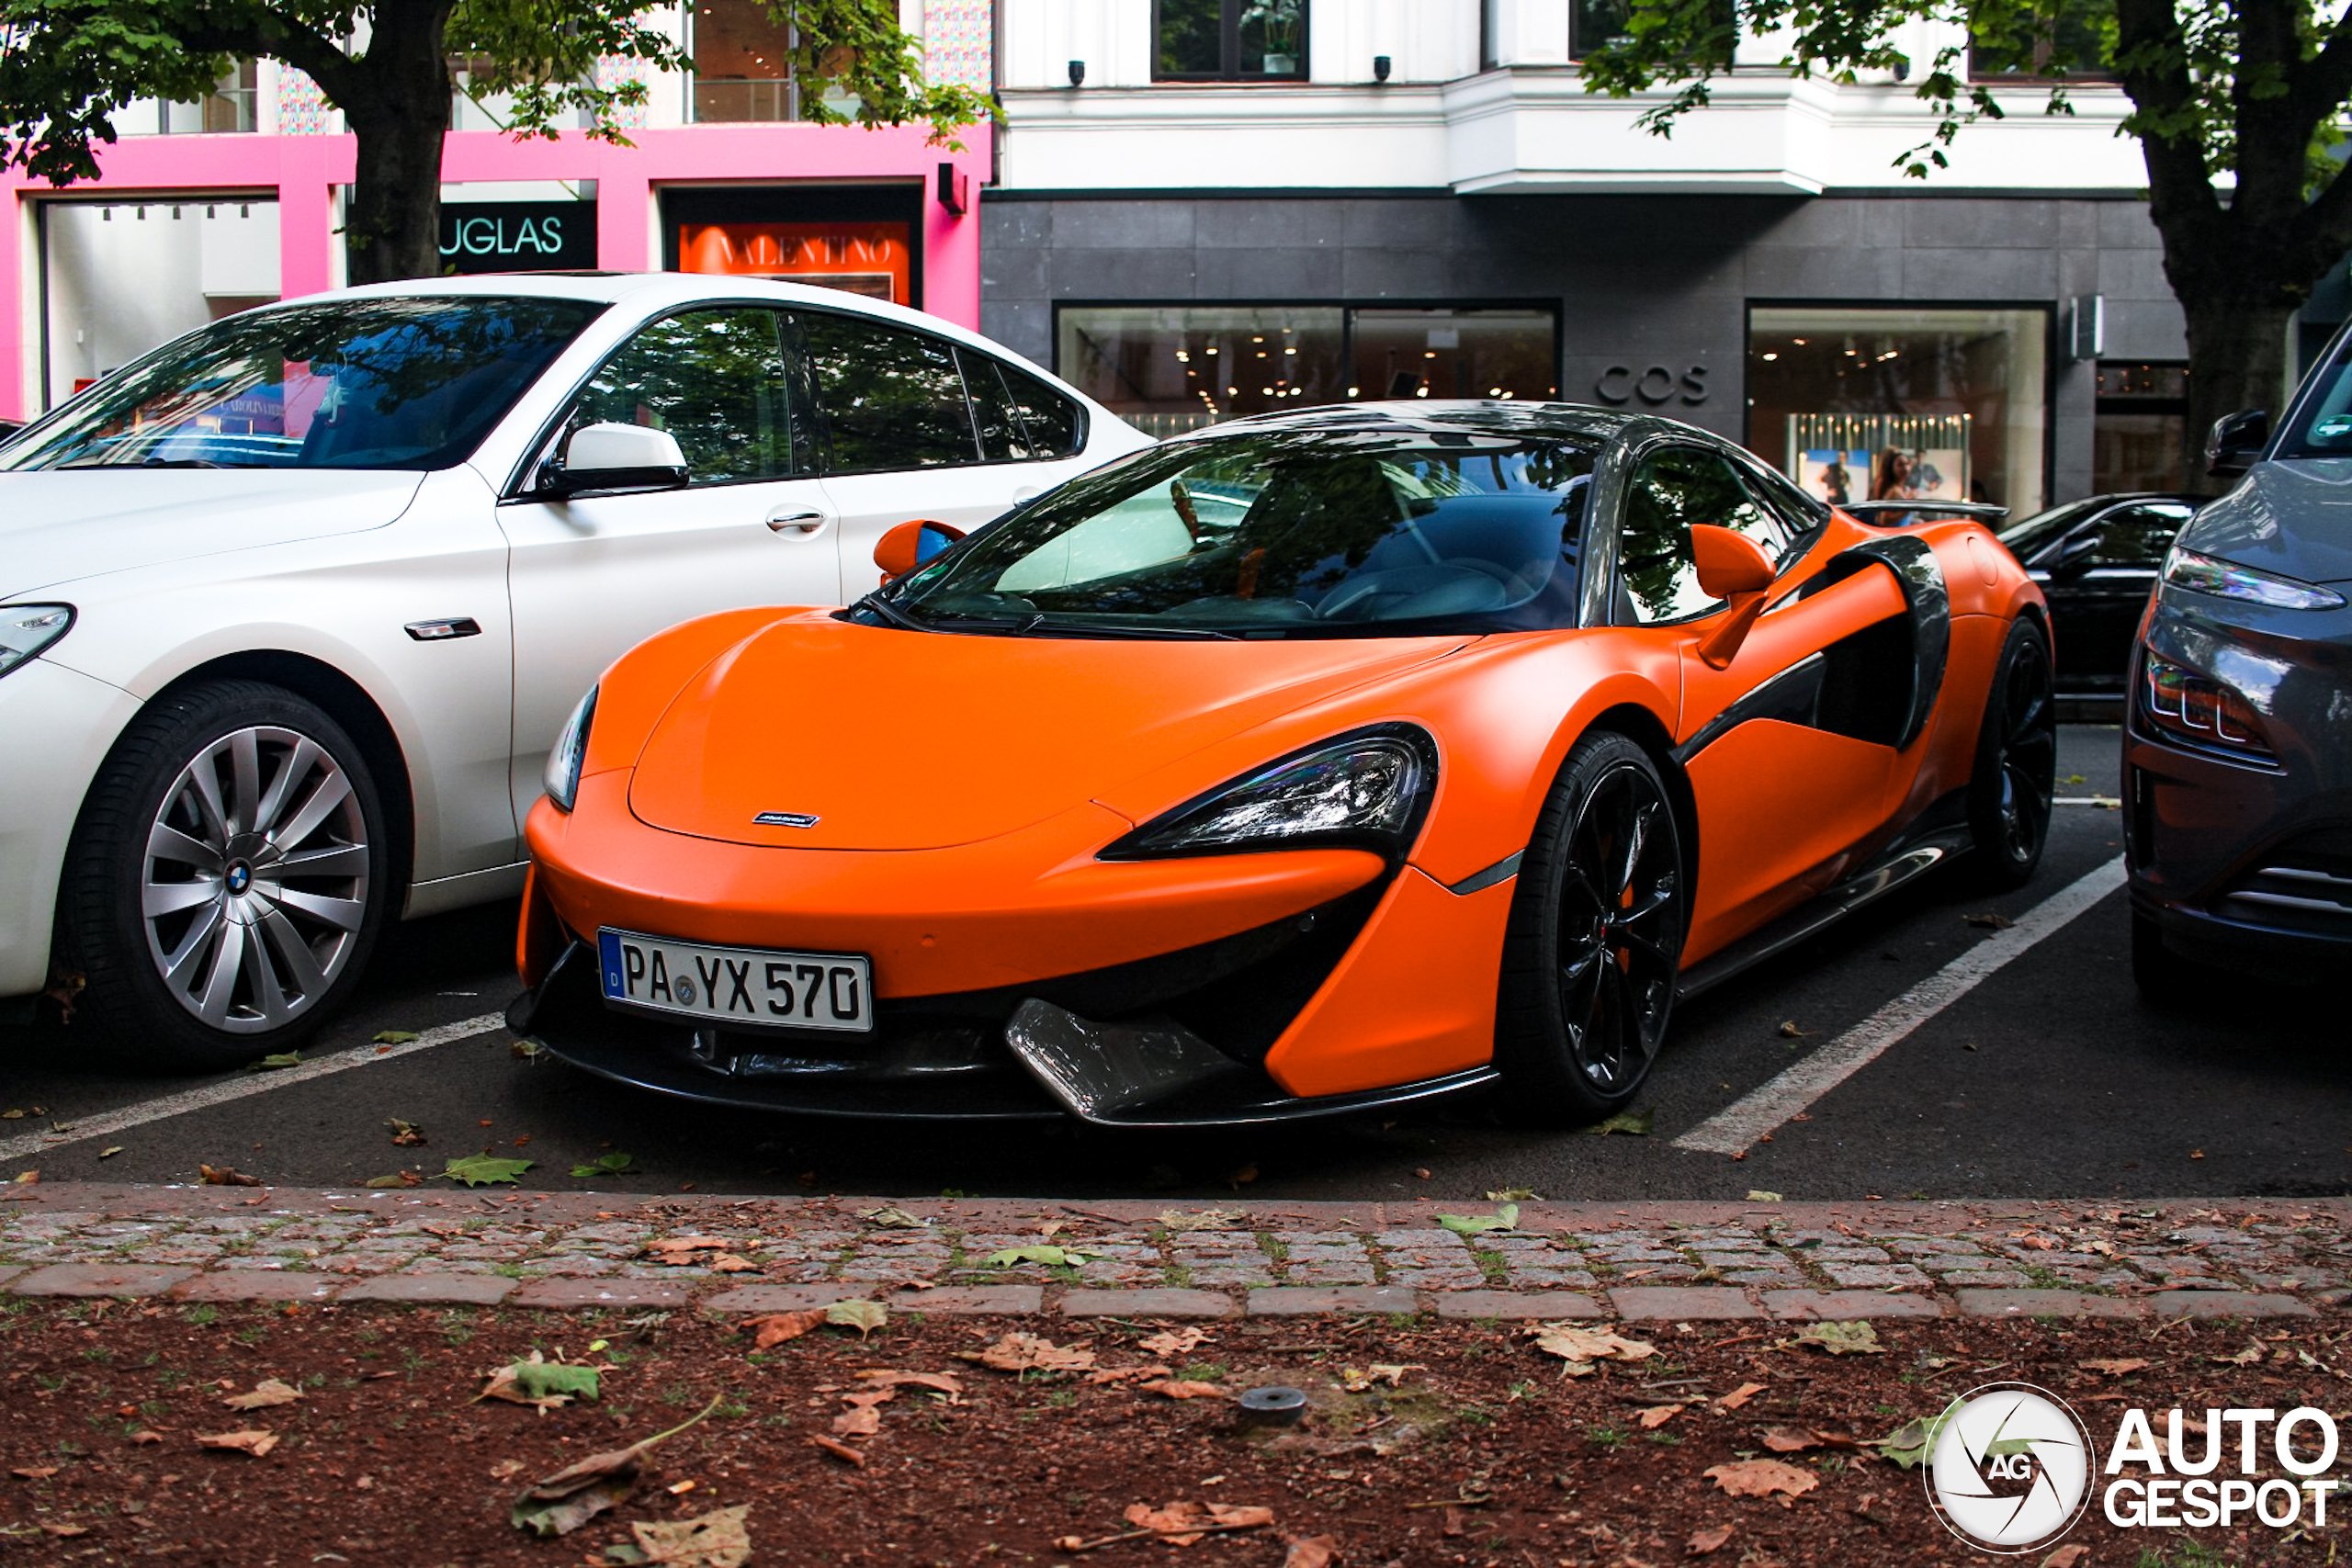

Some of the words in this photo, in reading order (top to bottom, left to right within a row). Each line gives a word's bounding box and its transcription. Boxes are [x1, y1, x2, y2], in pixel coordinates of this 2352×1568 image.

[720, 235, 891, 265] VALENTINO
[1595, 366, 1709, 406] COS
[610, 971, 619, 987] D
[623, 943, 673, 1002] PA
[695, 955, 755, 1013] YX
[765, 963, 859, 1020] 570
